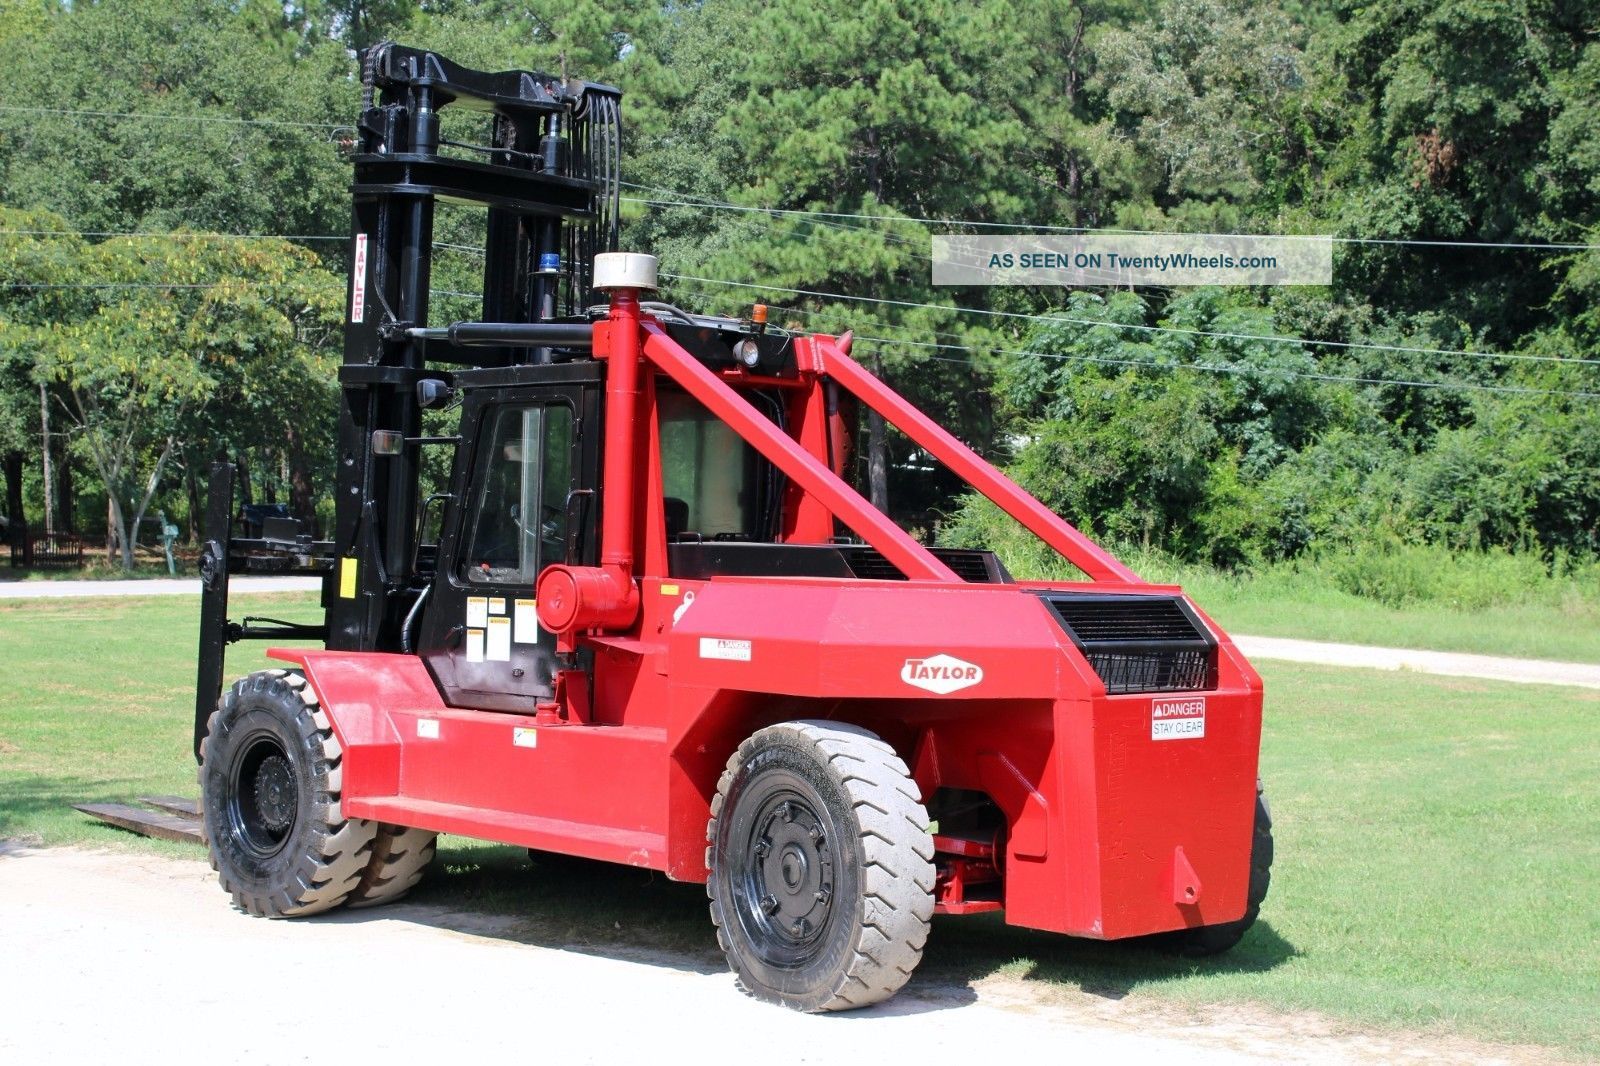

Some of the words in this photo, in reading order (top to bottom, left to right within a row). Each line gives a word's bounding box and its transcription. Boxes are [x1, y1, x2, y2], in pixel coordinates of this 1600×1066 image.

[354, 236, 366, 320] TAYLOR
[907, 660, 977, 679] TAYLOR
[1163, 702, 1203, 716] DANGER
[1154, 722, 1174, 734] STAY
[1175, 720, 1203, 733] CLEAR
